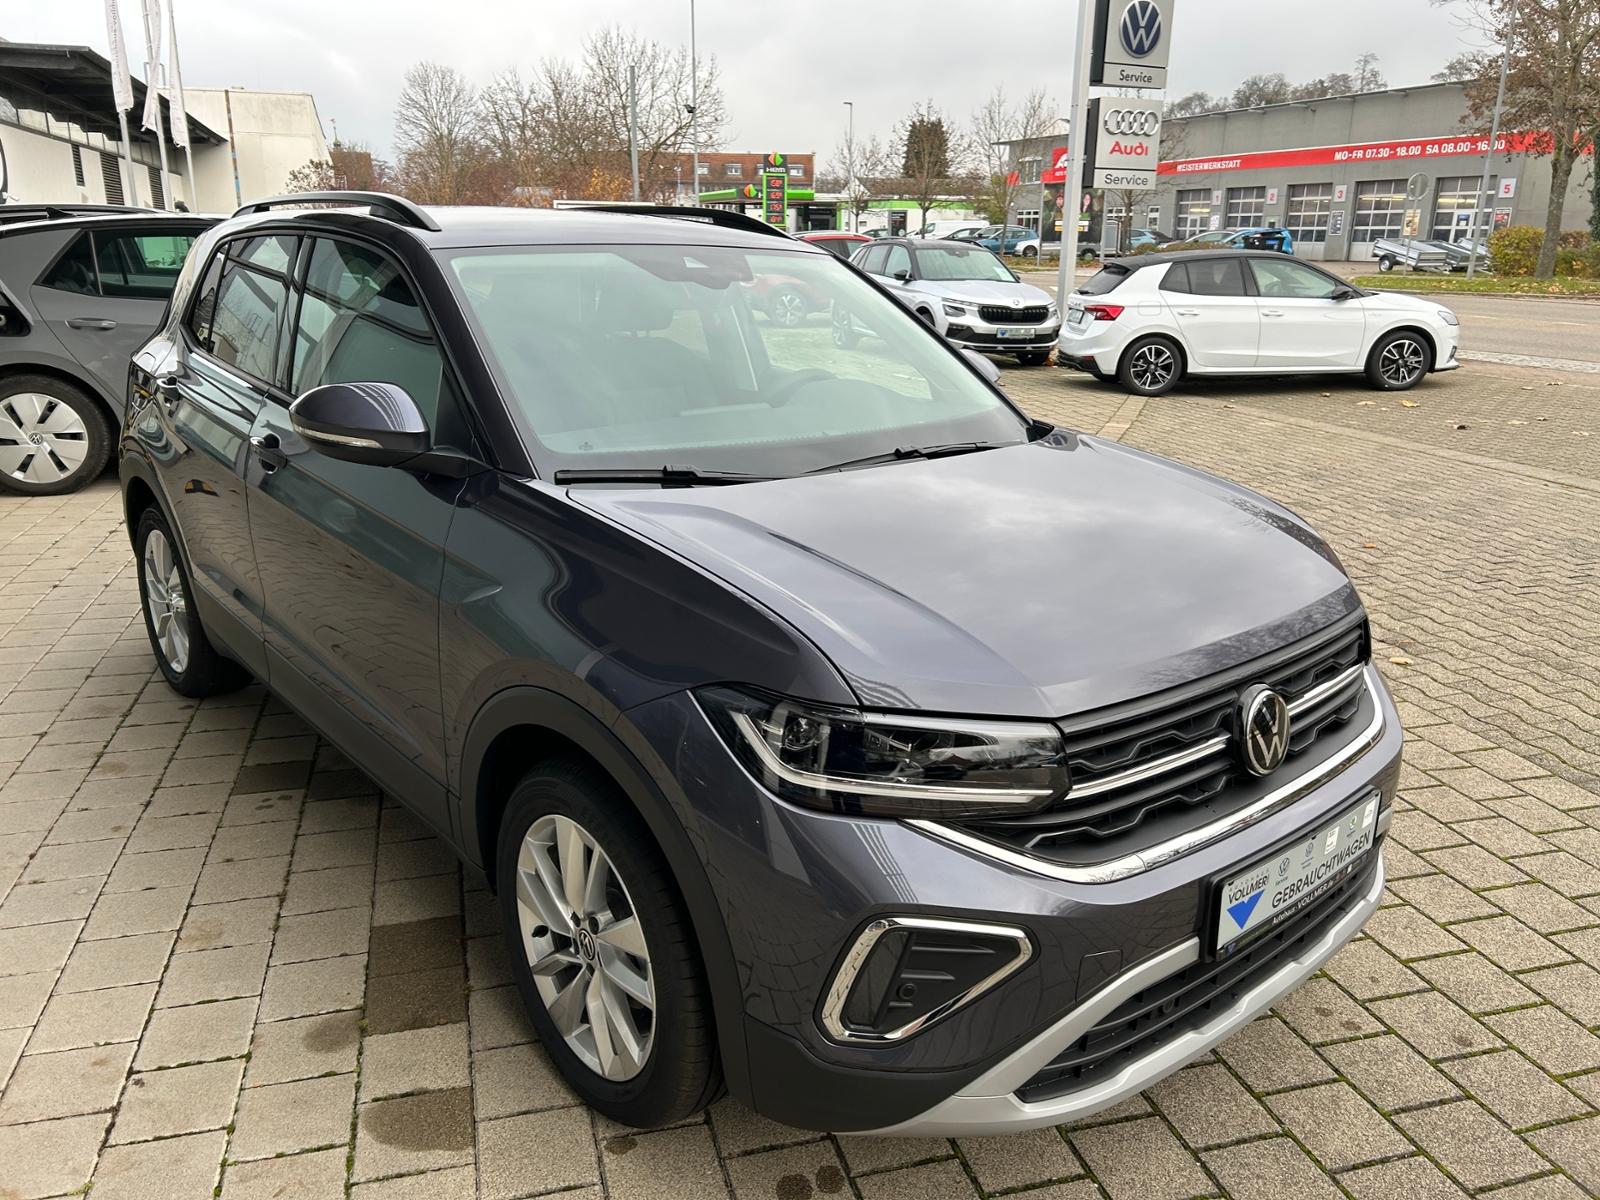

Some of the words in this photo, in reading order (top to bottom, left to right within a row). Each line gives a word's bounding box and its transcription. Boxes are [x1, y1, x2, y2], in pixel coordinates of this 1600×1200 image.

[1119, 69, 1152, 83] Service
[1109, 141, 1149, 156] Audi
[1334, 149, 1363, 161] MO-FR
[1425, 144, 1439, 155] SA
[1177, 159, 1241, 172] MEISTERWERKSTATT
[1104, 173, 1148, 186] Service
[1337, 190, 1344, 199] 3
[1504, 184, 1511, 194] 5
[1271, 830, 1371, 909] GEBRAUCHTWAGEN
